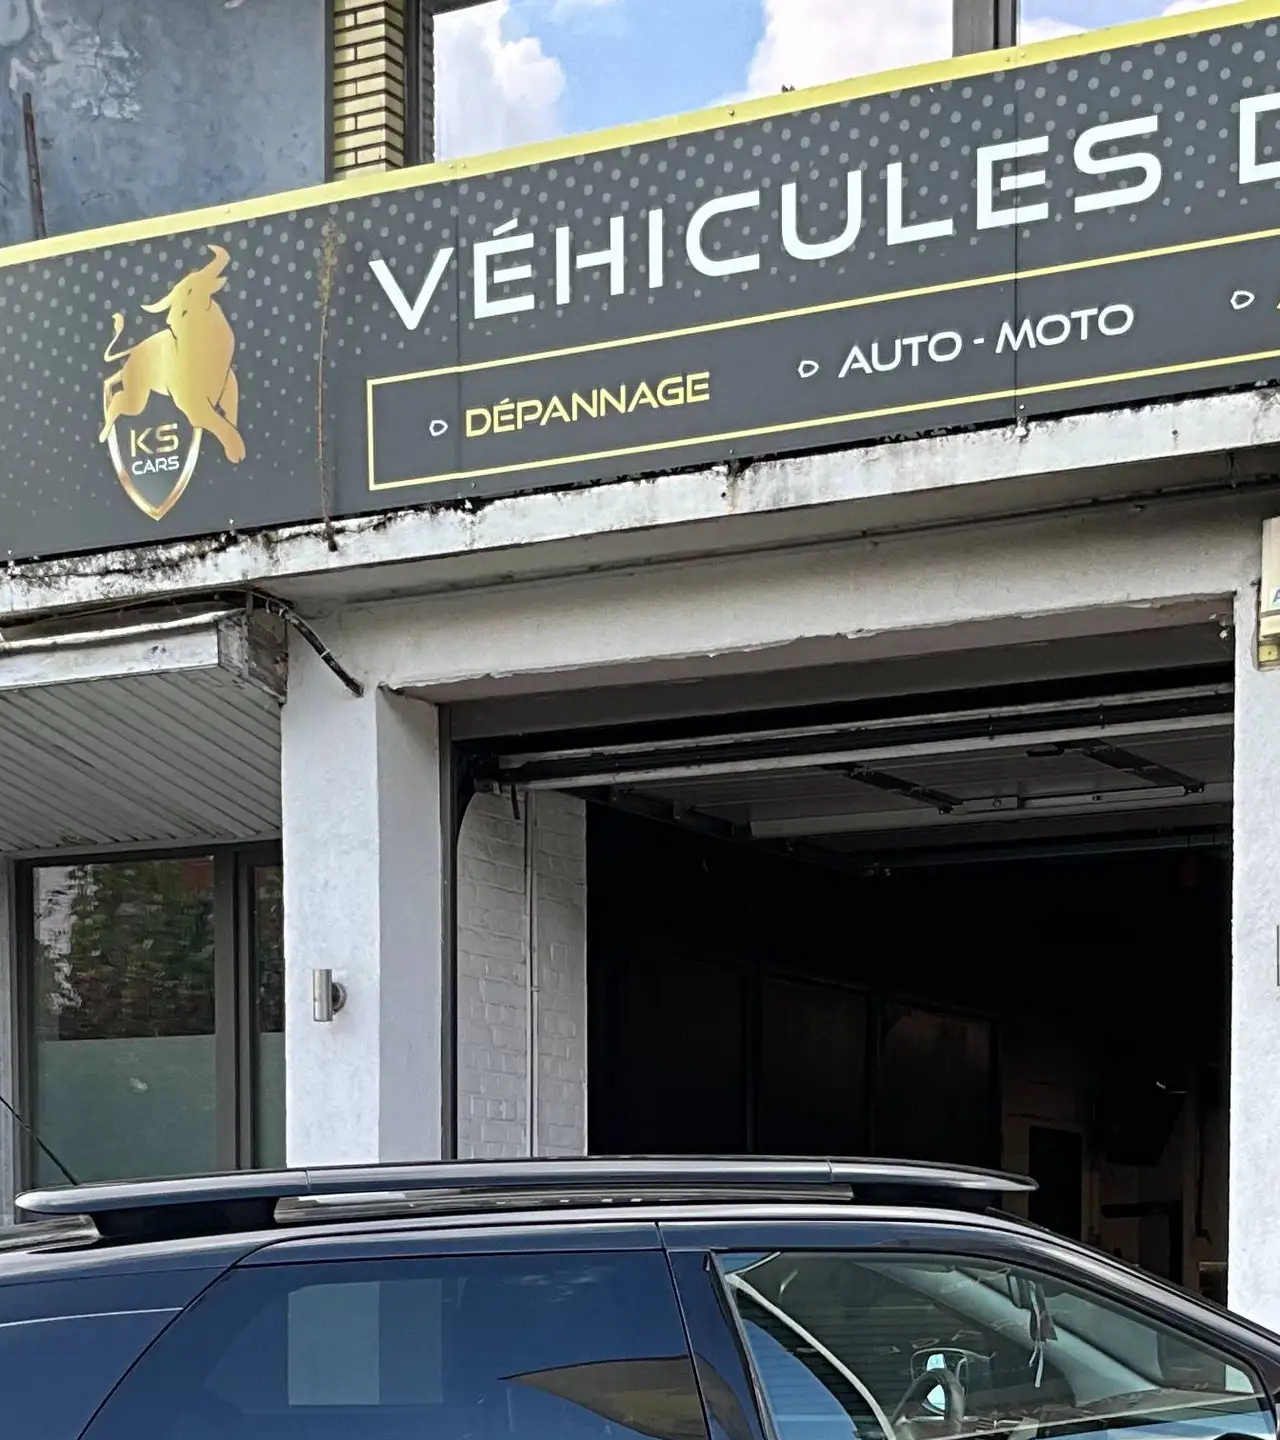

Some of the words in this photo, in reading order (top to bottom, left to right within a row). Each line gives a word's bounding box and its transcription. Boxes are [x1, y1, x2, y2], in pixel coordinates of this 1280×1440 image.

[369, 115, 1161, 330] VÉHICULES
[838, 331, 963, 379] AUTO
[995, 304, 1135, 353] MOTO
[465, 371, 710, 438] DÉPANNAGE
[130, 423, 179, 457] KS
[131, 455, 180, 476] CARS
